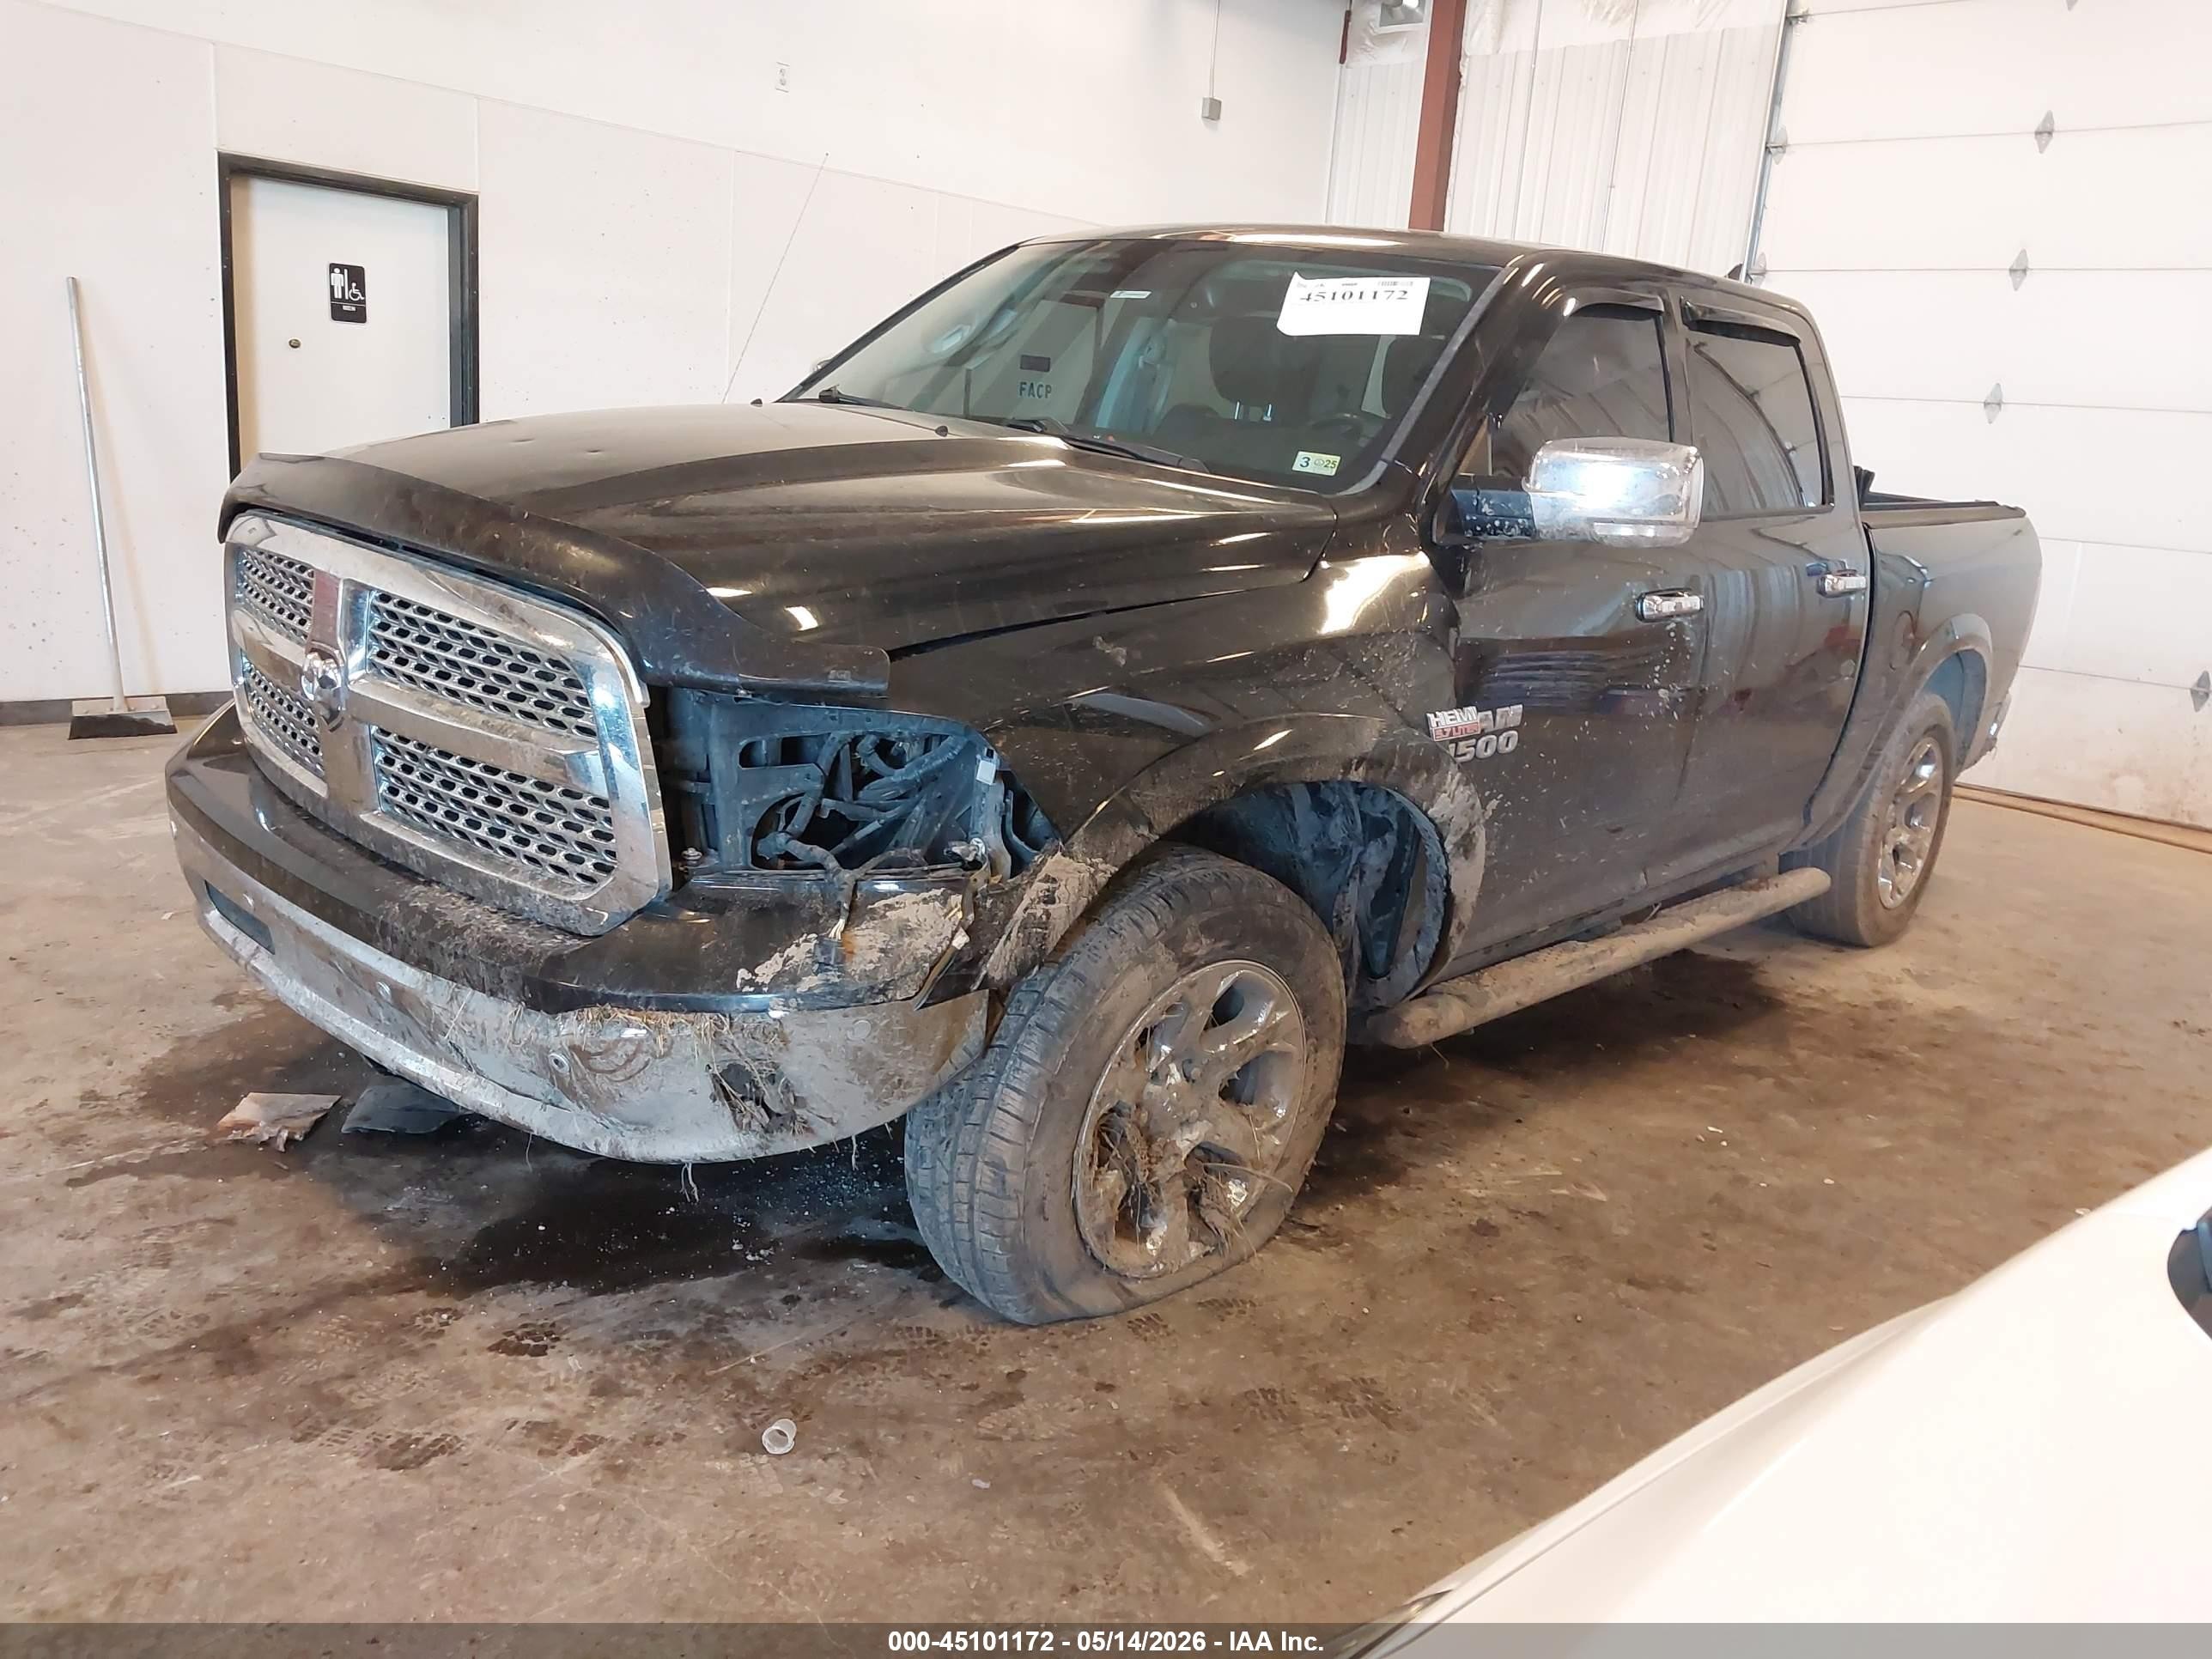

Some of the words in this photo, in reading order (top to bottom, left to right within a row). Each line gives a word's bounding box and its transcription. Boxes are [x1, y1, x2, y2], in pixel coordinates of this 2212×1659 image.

[1299, 289, 1409, 302] 45101172
[1018, 381, 1052, 399] FACP
[1299, 456, 1311, 468] 3
[1323, 459, 1338, 469] 25
[1425, 705, 1478, 728] HEMI
[1477, 703, 1524, 733] AM
[1448, 729, 1519, 763] 1500
